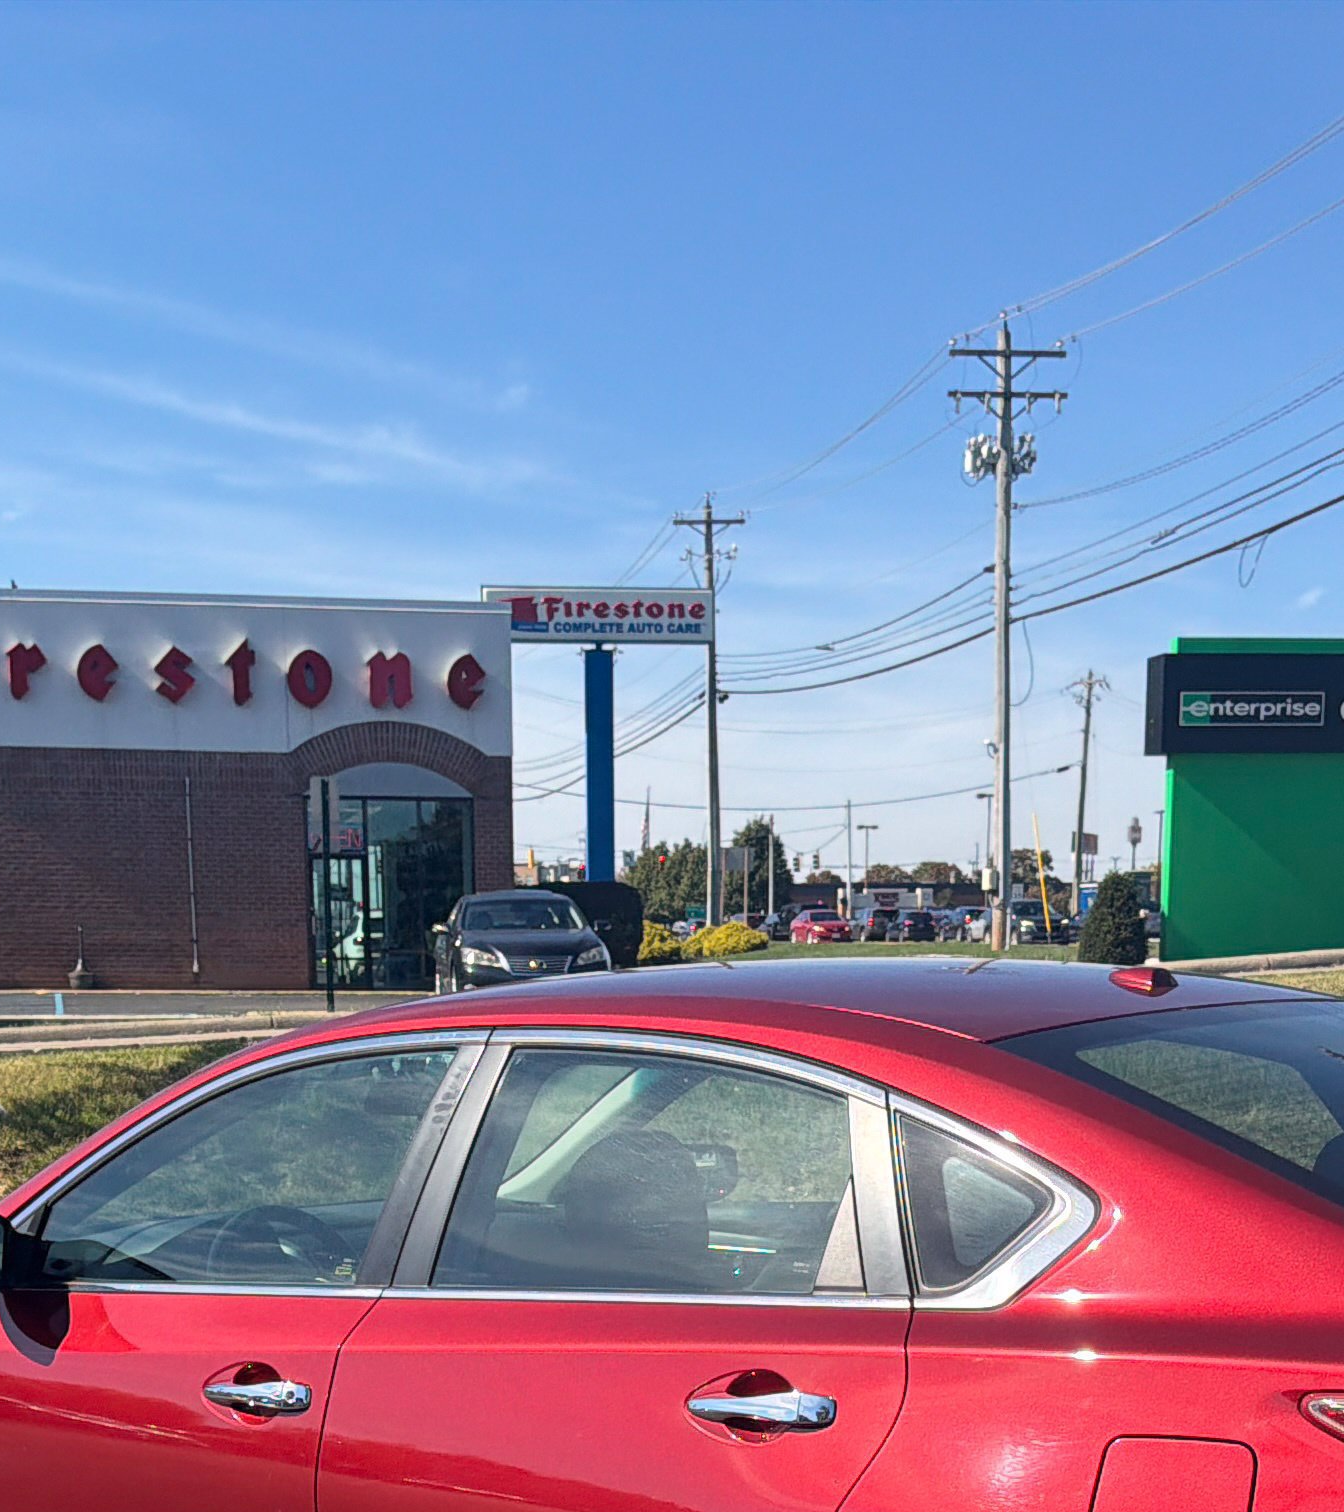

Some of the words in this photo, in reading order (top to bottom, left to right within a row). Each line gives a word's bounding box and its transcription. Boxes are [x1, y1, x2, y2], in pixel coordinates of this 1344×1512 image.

[541, 597, 707, 622] Firestone
[553, 622, 624, 633] COMPLETE
[627, 622, 662, 633] AUTO
[667, 623, 702, 634] CARE
[1184, 697, 1321, 721] enterprise
